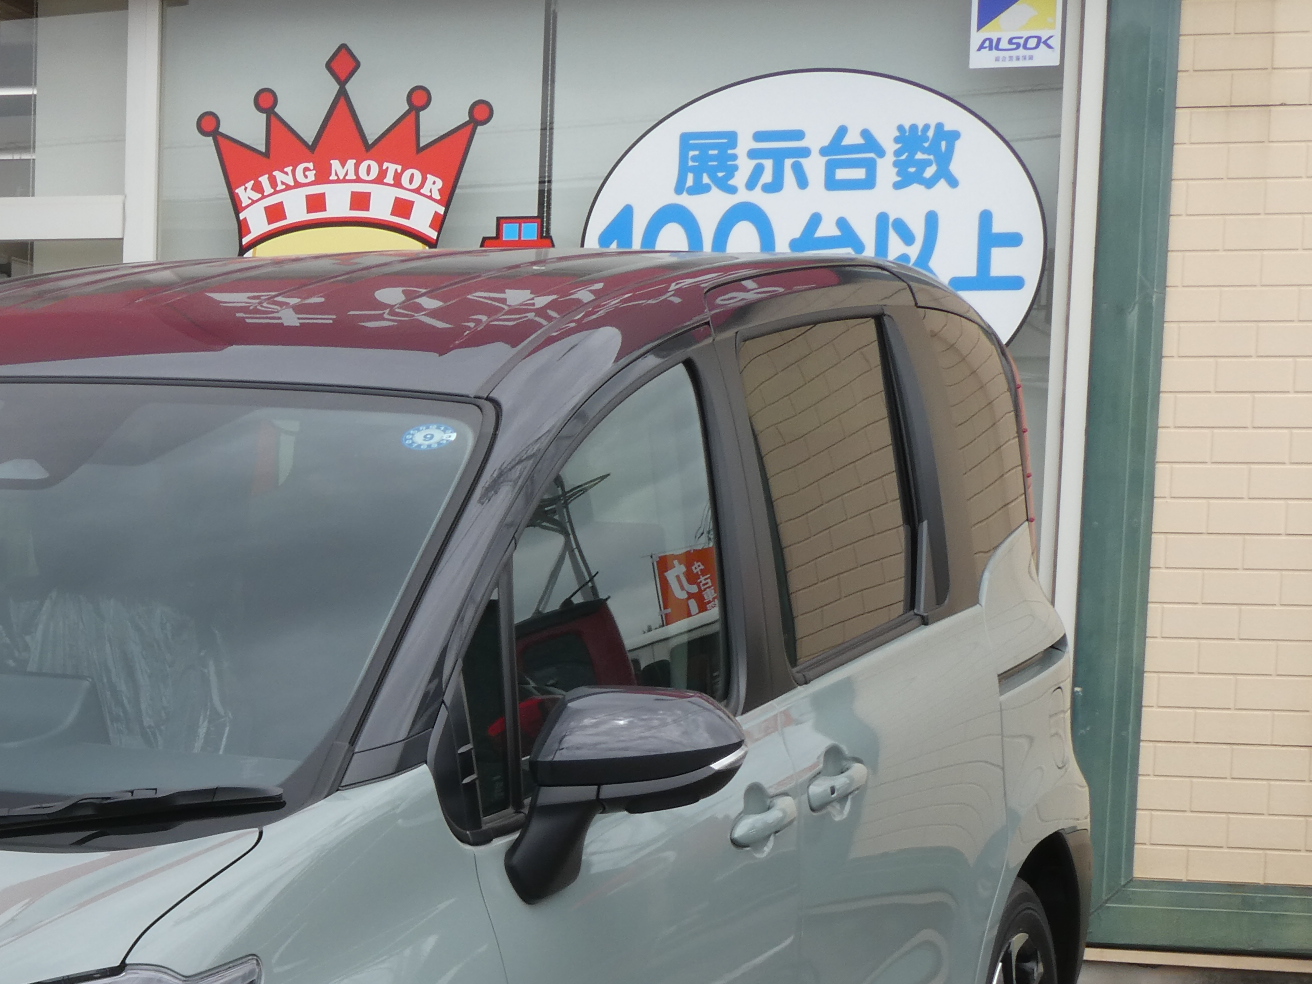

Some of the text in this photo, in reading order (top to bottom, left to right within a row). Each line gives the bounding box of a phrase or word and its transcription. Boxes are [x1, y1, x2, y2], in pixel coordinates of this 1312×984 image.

[976, 35, 1055, 52] ALSOK
[674, 122, 962, 195] 展示台数
[235, 159, 444, 207] KING MOTOR
